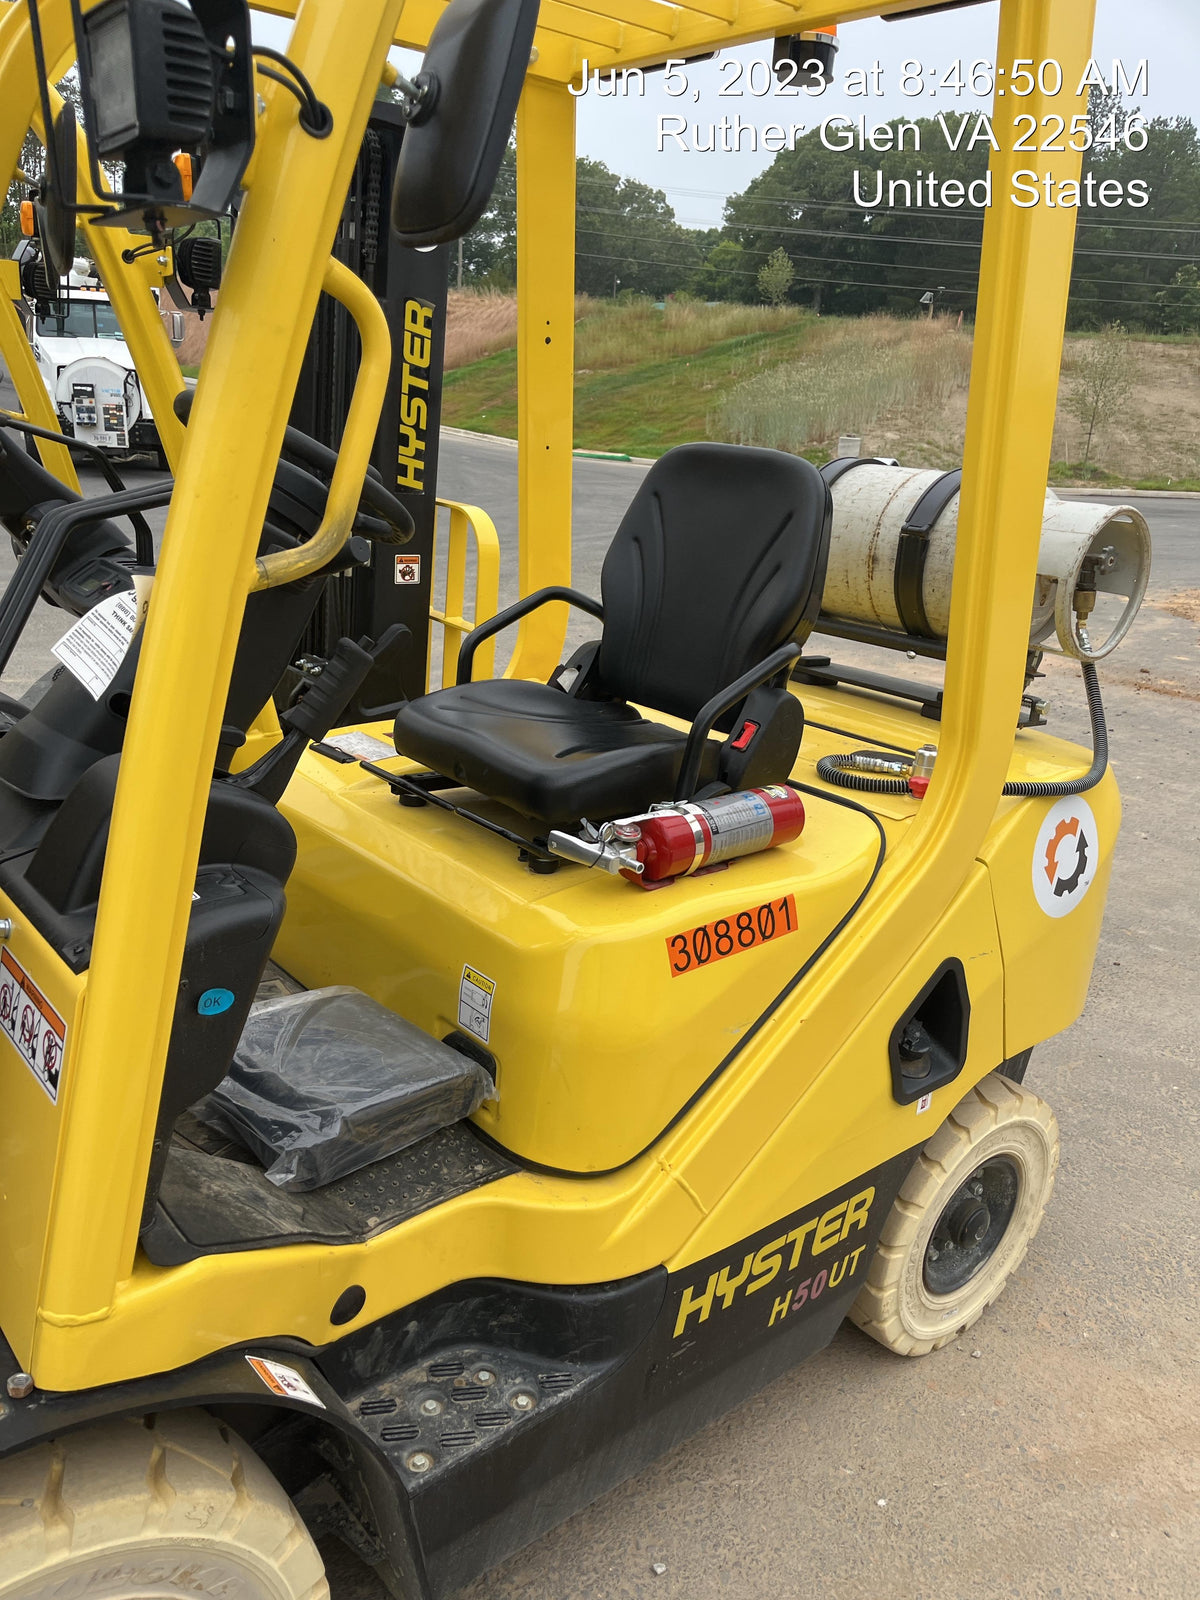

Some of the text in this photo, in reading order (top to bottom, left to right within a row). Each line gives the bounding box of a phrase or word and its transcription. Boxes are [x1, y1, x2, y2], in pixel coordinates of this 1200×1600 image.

[397, 299, 433, 491] HYSTER
[671, 896, 791, 972] 308801
[203, 996, 222, 1009] OK
[472, 975, 492, 992] CAUTION
[672, 1186, 876, 1339] HYSTER
[767, 1244, 867, 1328] H50UT
